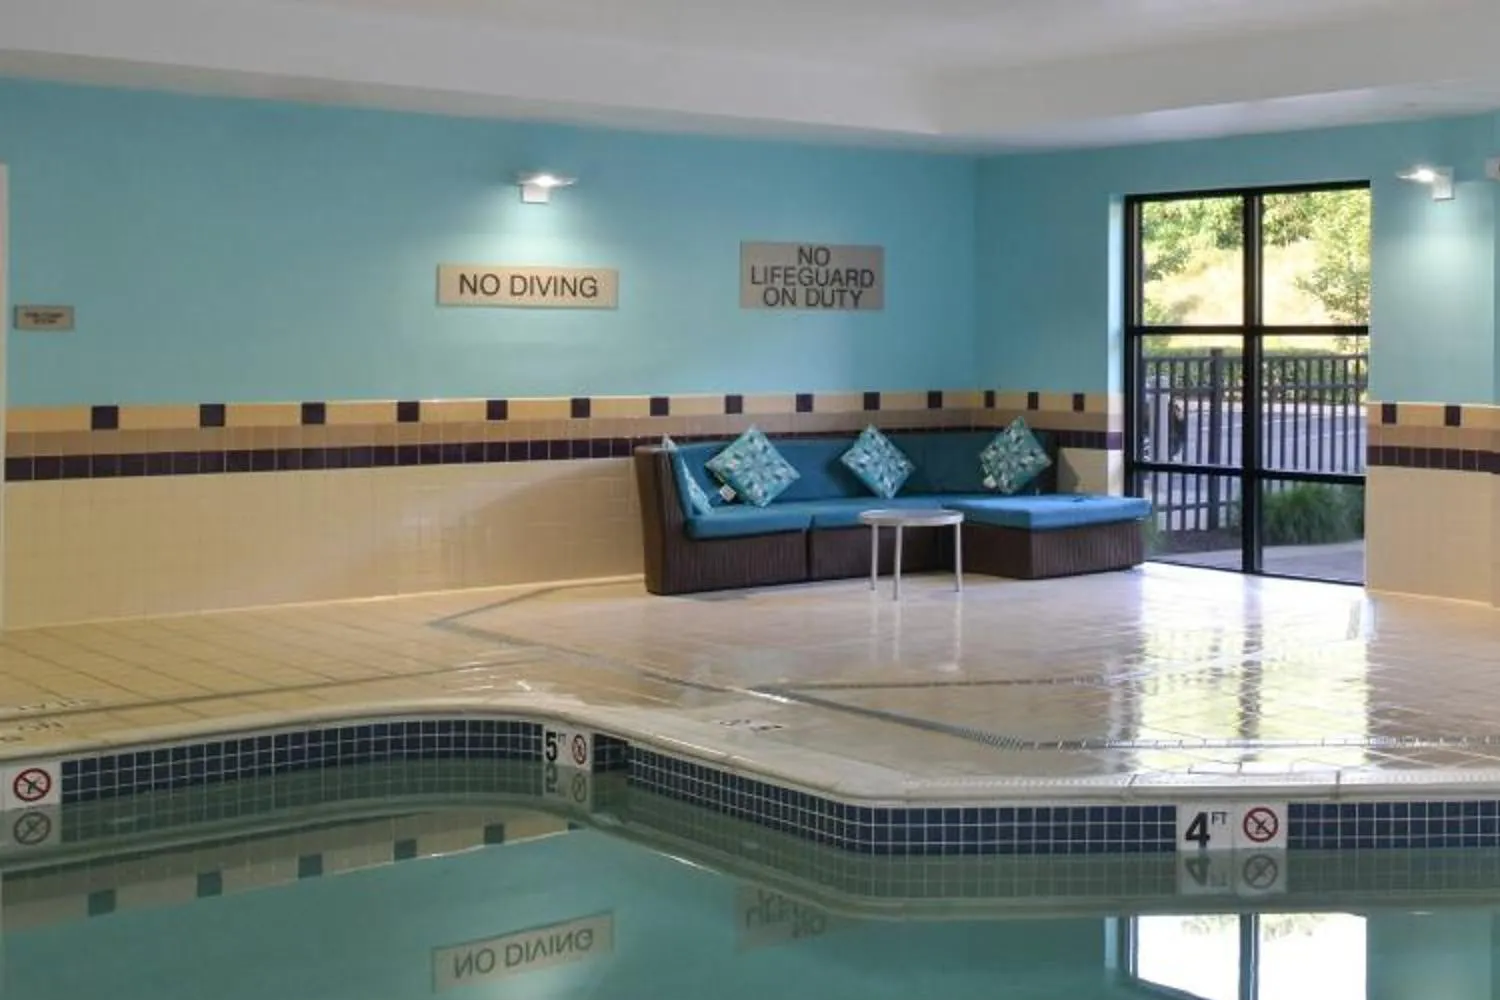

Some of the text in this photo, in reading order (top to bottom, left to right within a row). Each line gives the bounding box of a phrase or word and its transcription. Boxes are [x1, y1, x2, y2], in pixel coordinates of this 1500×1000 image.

[798, 246, 831, 267] NO
[459, 273, 599, 298] NO DIVING
[751, 265, 875, 288] LIFEGUARD
[763, 287, 863, 308] ON DUTY
[546, 731, 557, 762] 5
[1184, 811, 1227, 849] 4 FT
